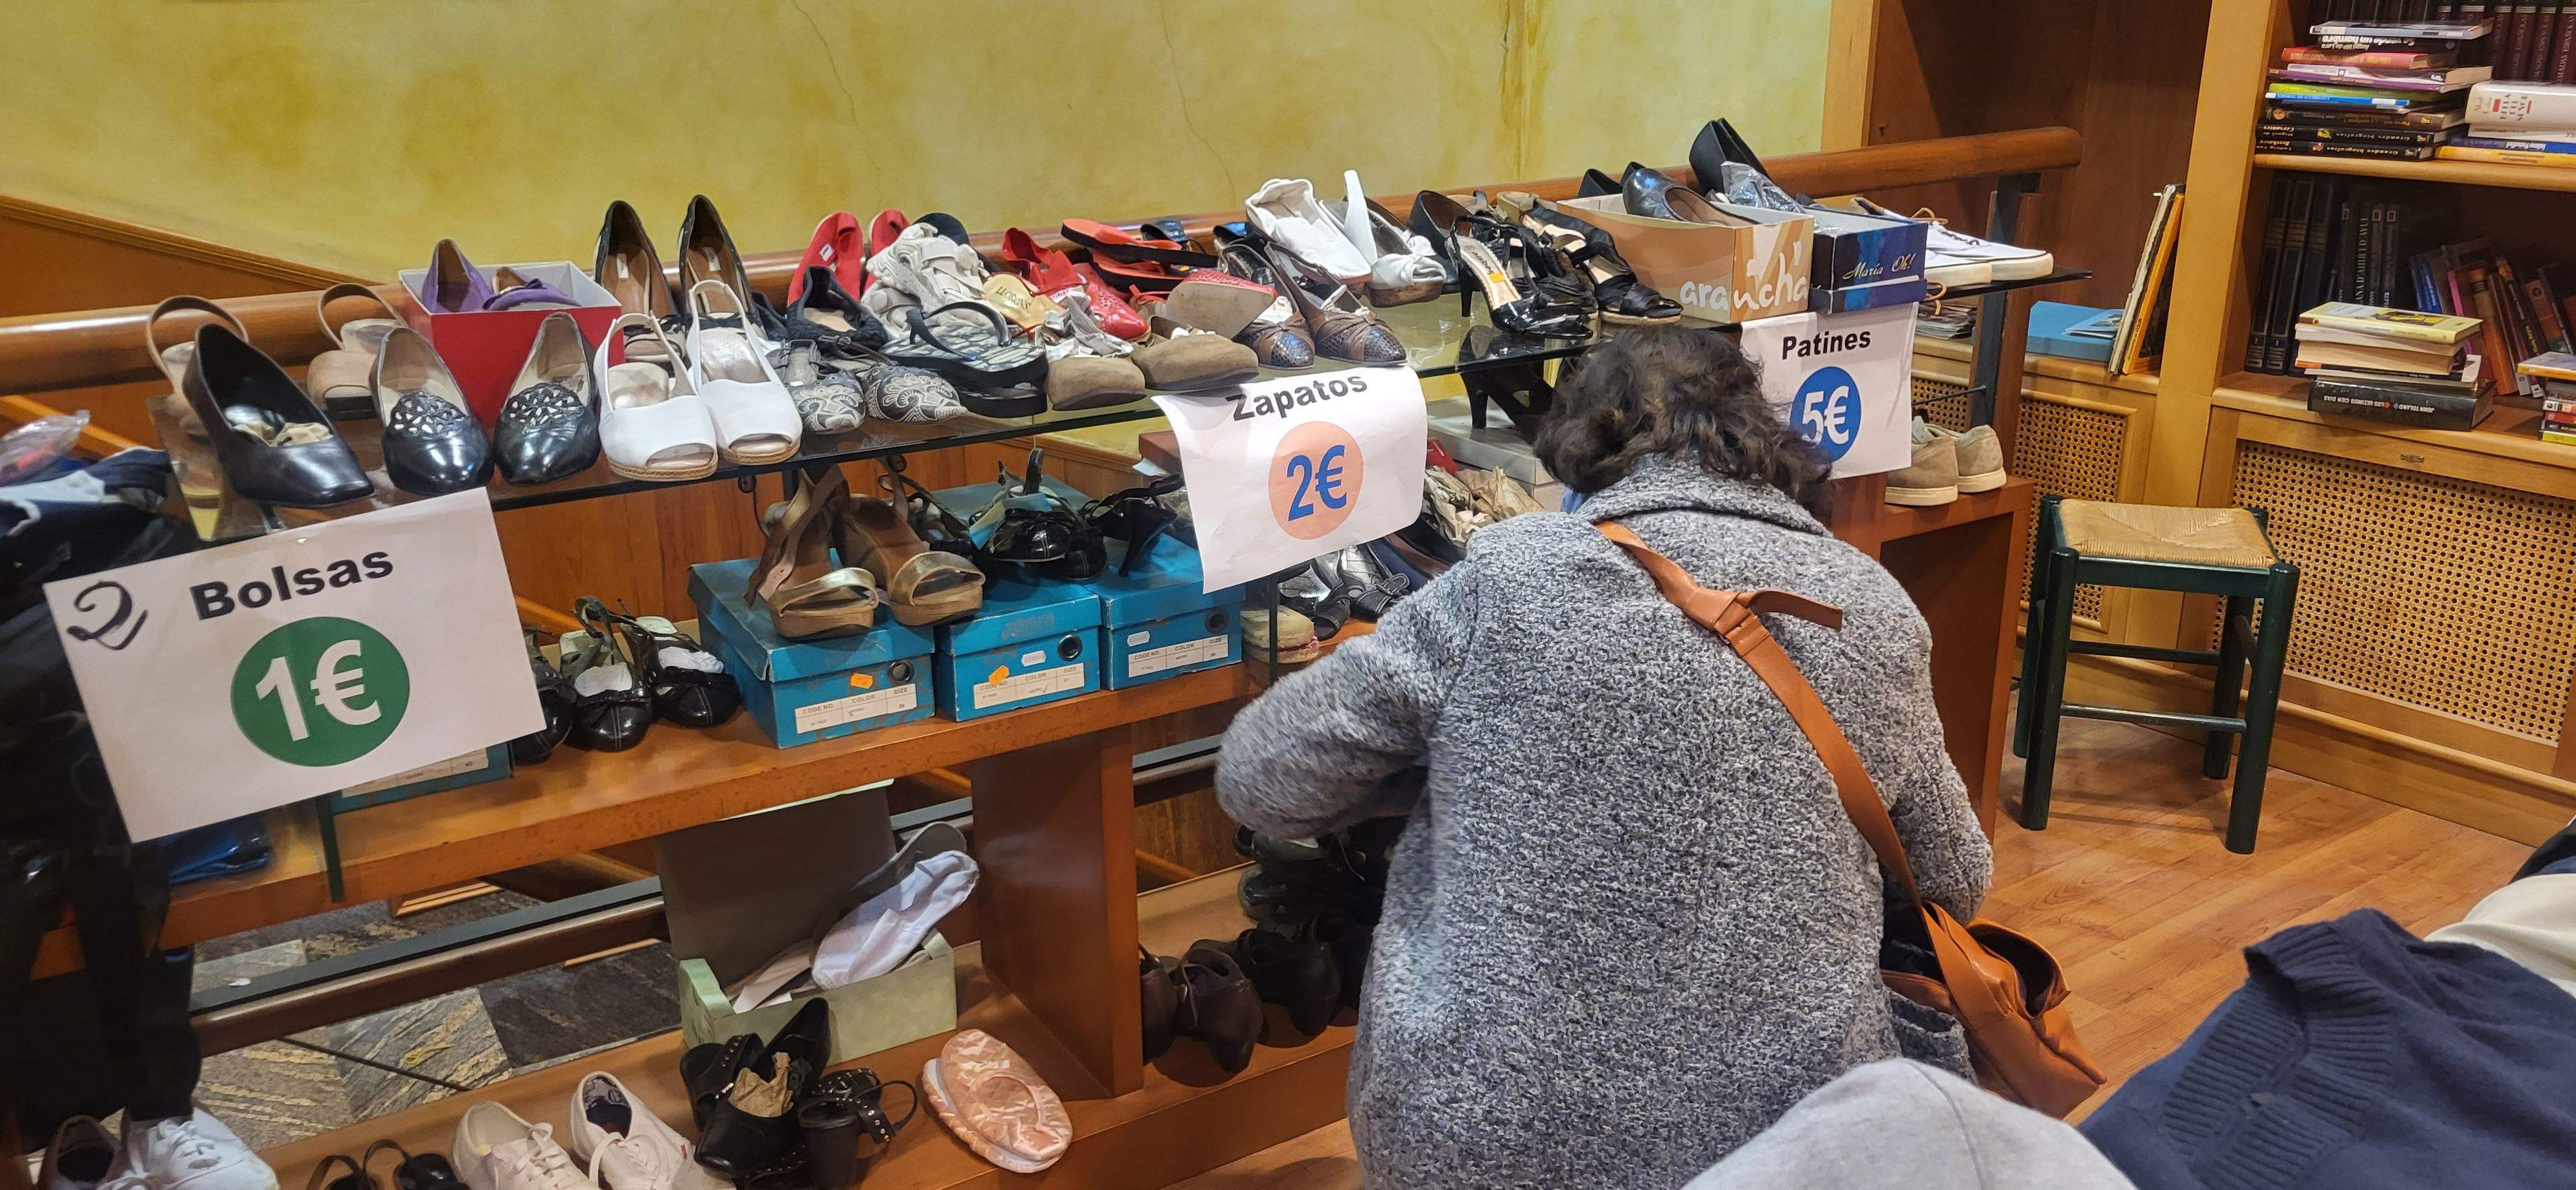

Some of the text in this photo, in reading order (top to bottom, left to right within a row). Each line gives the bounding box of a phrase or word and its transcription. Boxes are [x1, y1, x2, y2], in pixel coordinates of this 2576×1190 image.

[2322, 35, 2359, 44] hombre
[1680, 252, 1808, 310] arancha
[1842, 252, 1917, 280] María Oh!
[995, 286, 1030, 310] LLORENS
[1782, 330, 1871, 360] Patines
[1224, 374, 1368, 421] Zapatos
[2420, 404, 2435, 413] JOHN
[1801, 386, 1850, 445] 5€
[1286, 444, 1347, 522] 2€
[189, 551, 394, 621] Bolsas
[67, 580, 149, 651] 2
[1175, 643, 1195, 651] COLOR
[255, 639, 382, 742] 1€
[1025, 672, 1047, 681] COLOR
[802, 706, 822, 715] CODE
[852, 694, 876, 704] COLOR
[893, 686, 908, 695] SIZE
